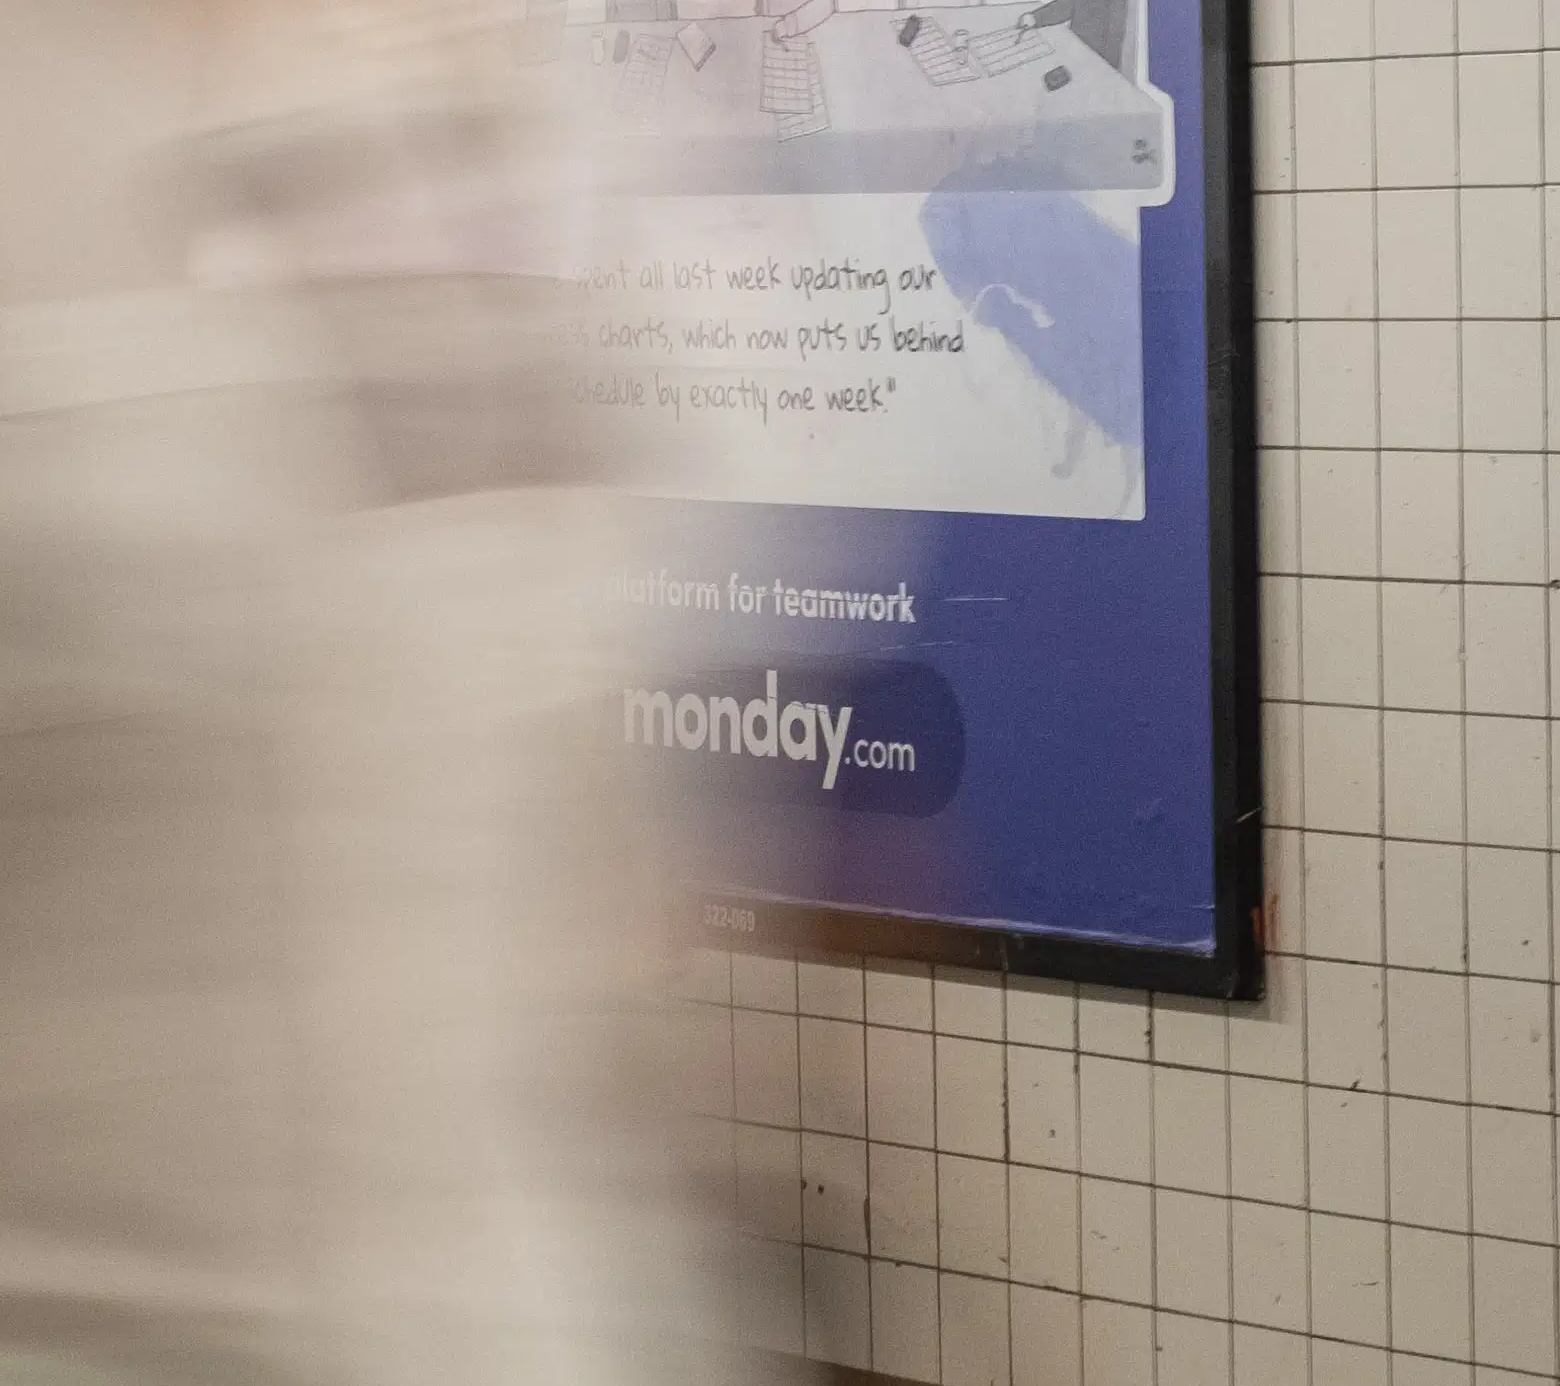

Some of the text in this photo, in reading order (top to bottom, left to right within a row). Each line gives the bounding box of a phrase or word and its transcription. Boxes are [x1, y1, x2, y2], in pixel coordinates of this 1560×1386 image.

[639, 262, 666, 290] all
[673, 258, 717, 290] last
[726, 256, 781, 292] week
[791, 257, 890, 315] updating
[899, 265, 937, 294] our
[598, 319, 673, 354] charts,
[682, 319, 737, 352] which
[746, 326, 788, 353] now
[797, 321, 848, 362] puts
[856, 322, 881, 353] us
[891, 317, 966, 353] behind
[654, 372, 681, 424] by
[689, 377, 769, 424] exactly
[777, 385, 816, 412] one
[605, 567, 917, 623] platform for teamwork
[623, 668, 915, 790] monday.com
